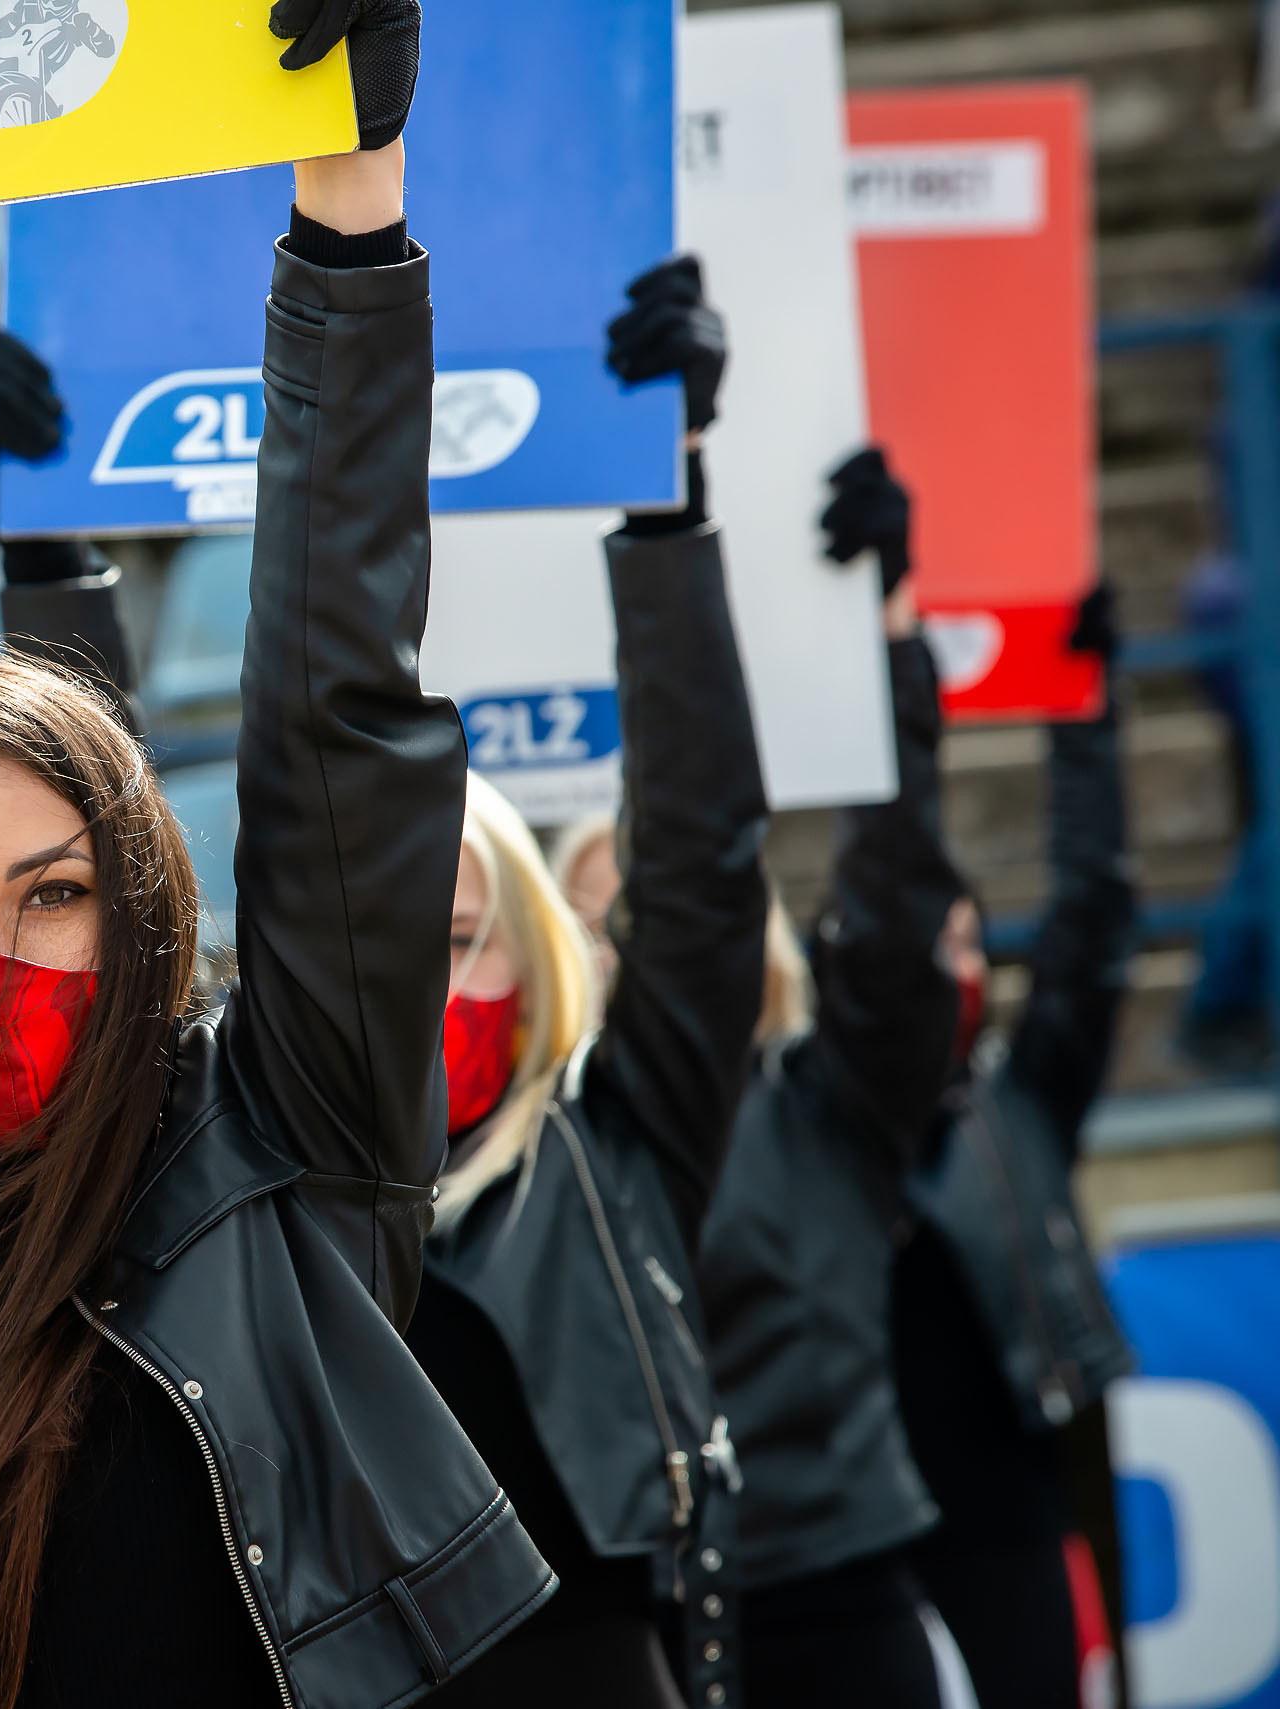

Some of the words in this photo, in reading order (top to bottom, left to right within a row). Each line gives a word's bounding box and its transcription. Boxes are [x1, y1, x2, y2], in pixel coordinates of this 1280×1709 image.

[21, 28, 34, 47] 2
[173, 392, 261, 460] 2L
[468, 685, 589, 764] 2LŻ
